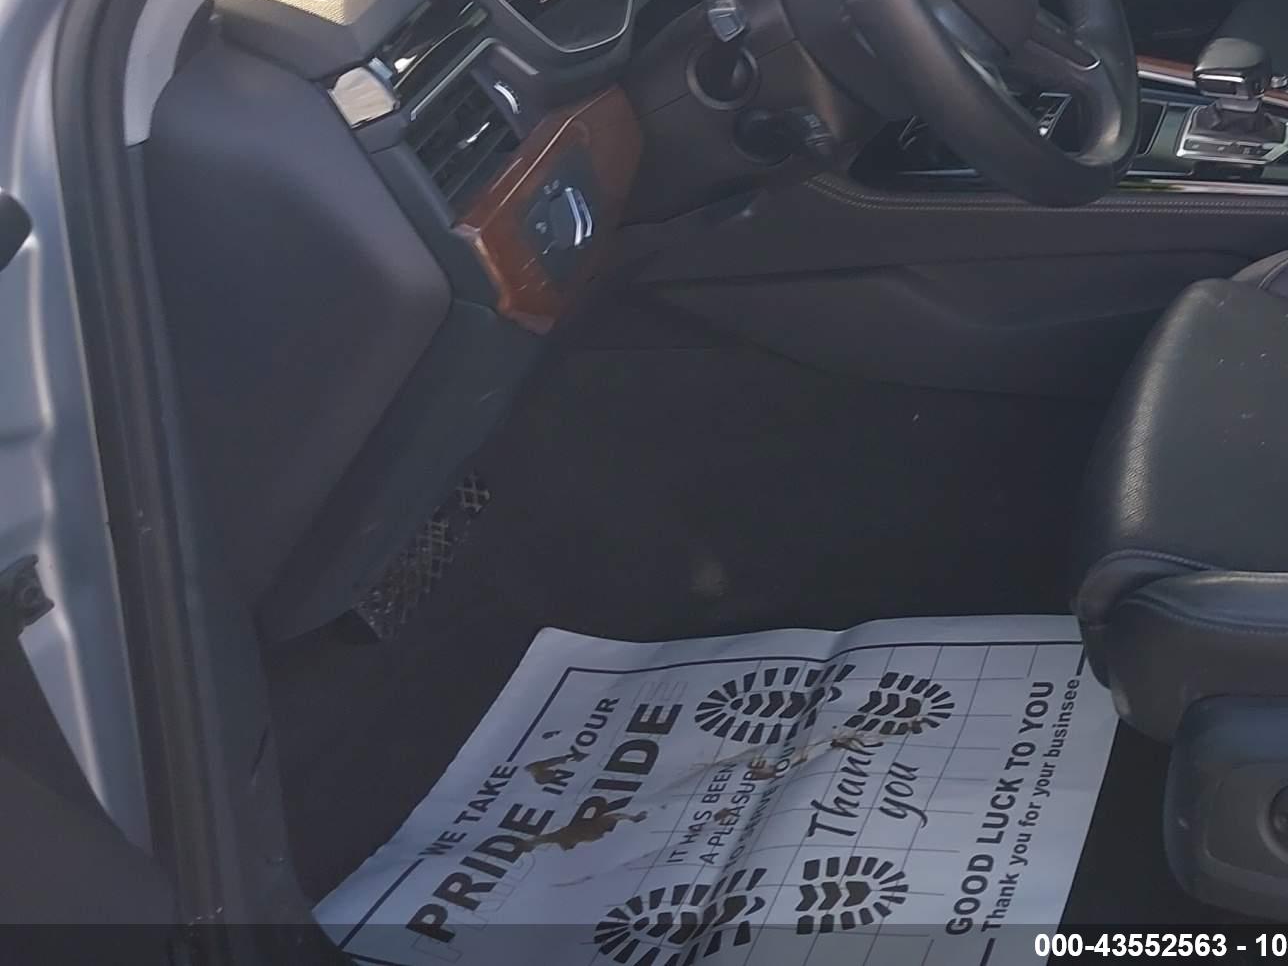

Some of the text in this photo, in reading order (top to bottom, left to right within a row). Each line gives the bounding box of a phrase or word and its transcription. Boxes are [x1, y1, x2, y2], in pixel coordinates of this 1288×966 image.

[542, 697, 620, 795] IN YOUR
[567, 704, 684, 833] RIDE
[806, 738, 884, 837] Thank
[879, 762, 928, 828] you
[418, 765, 519, 856] WE TAKE
[667, 763, 737, 863] IT HAS BEEN
[700, 758, 767, 865] A PLEASURE
[945, 681, 1055, 936] GOOD LUCK TO YOU
[981, 679, 1080, 933] Thank you for your businsee
[405, 803, 555, 944] PRIDE
